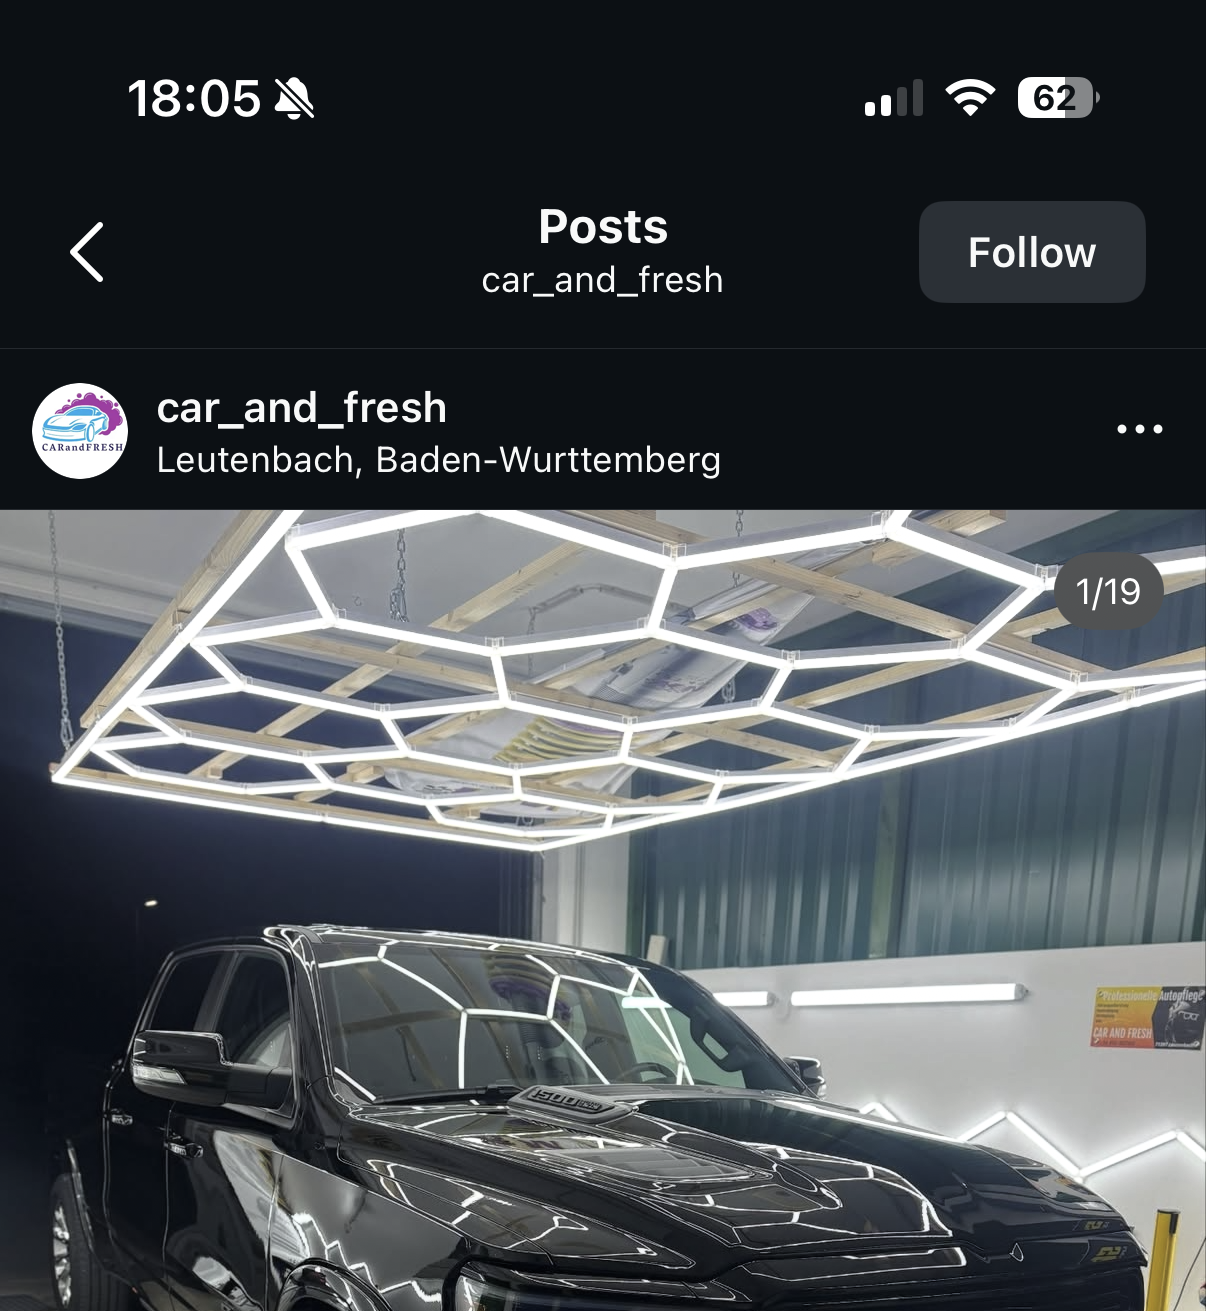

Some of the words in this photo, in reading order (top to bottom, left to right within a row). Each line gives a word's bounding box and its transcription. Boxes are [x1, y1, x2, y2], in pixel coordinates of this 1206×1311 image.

[129, 79, 260, 117] 18:05
[1034, 84, 1076, 111] 62
[541, 209, 667, 244] Posts
[970, 236, 1096, 268] Follow
[483, 265, 722, 297] car_and_fresh
[158, 390, 445, 429] car_and_fresh
[42, 443, 123, 452] CARandFRESH
[159, 445, 361, 479] Leutenbach,
[378, 445, 719, 479] Baden-Wurttemberg
[1093, 1027, 1108, 1038] CAR
[1110, 1027, 1124, 1038] AND
[1127, 1027, 1153, 1039] FRESH
[532, 1089, 578, 1107] 1500
